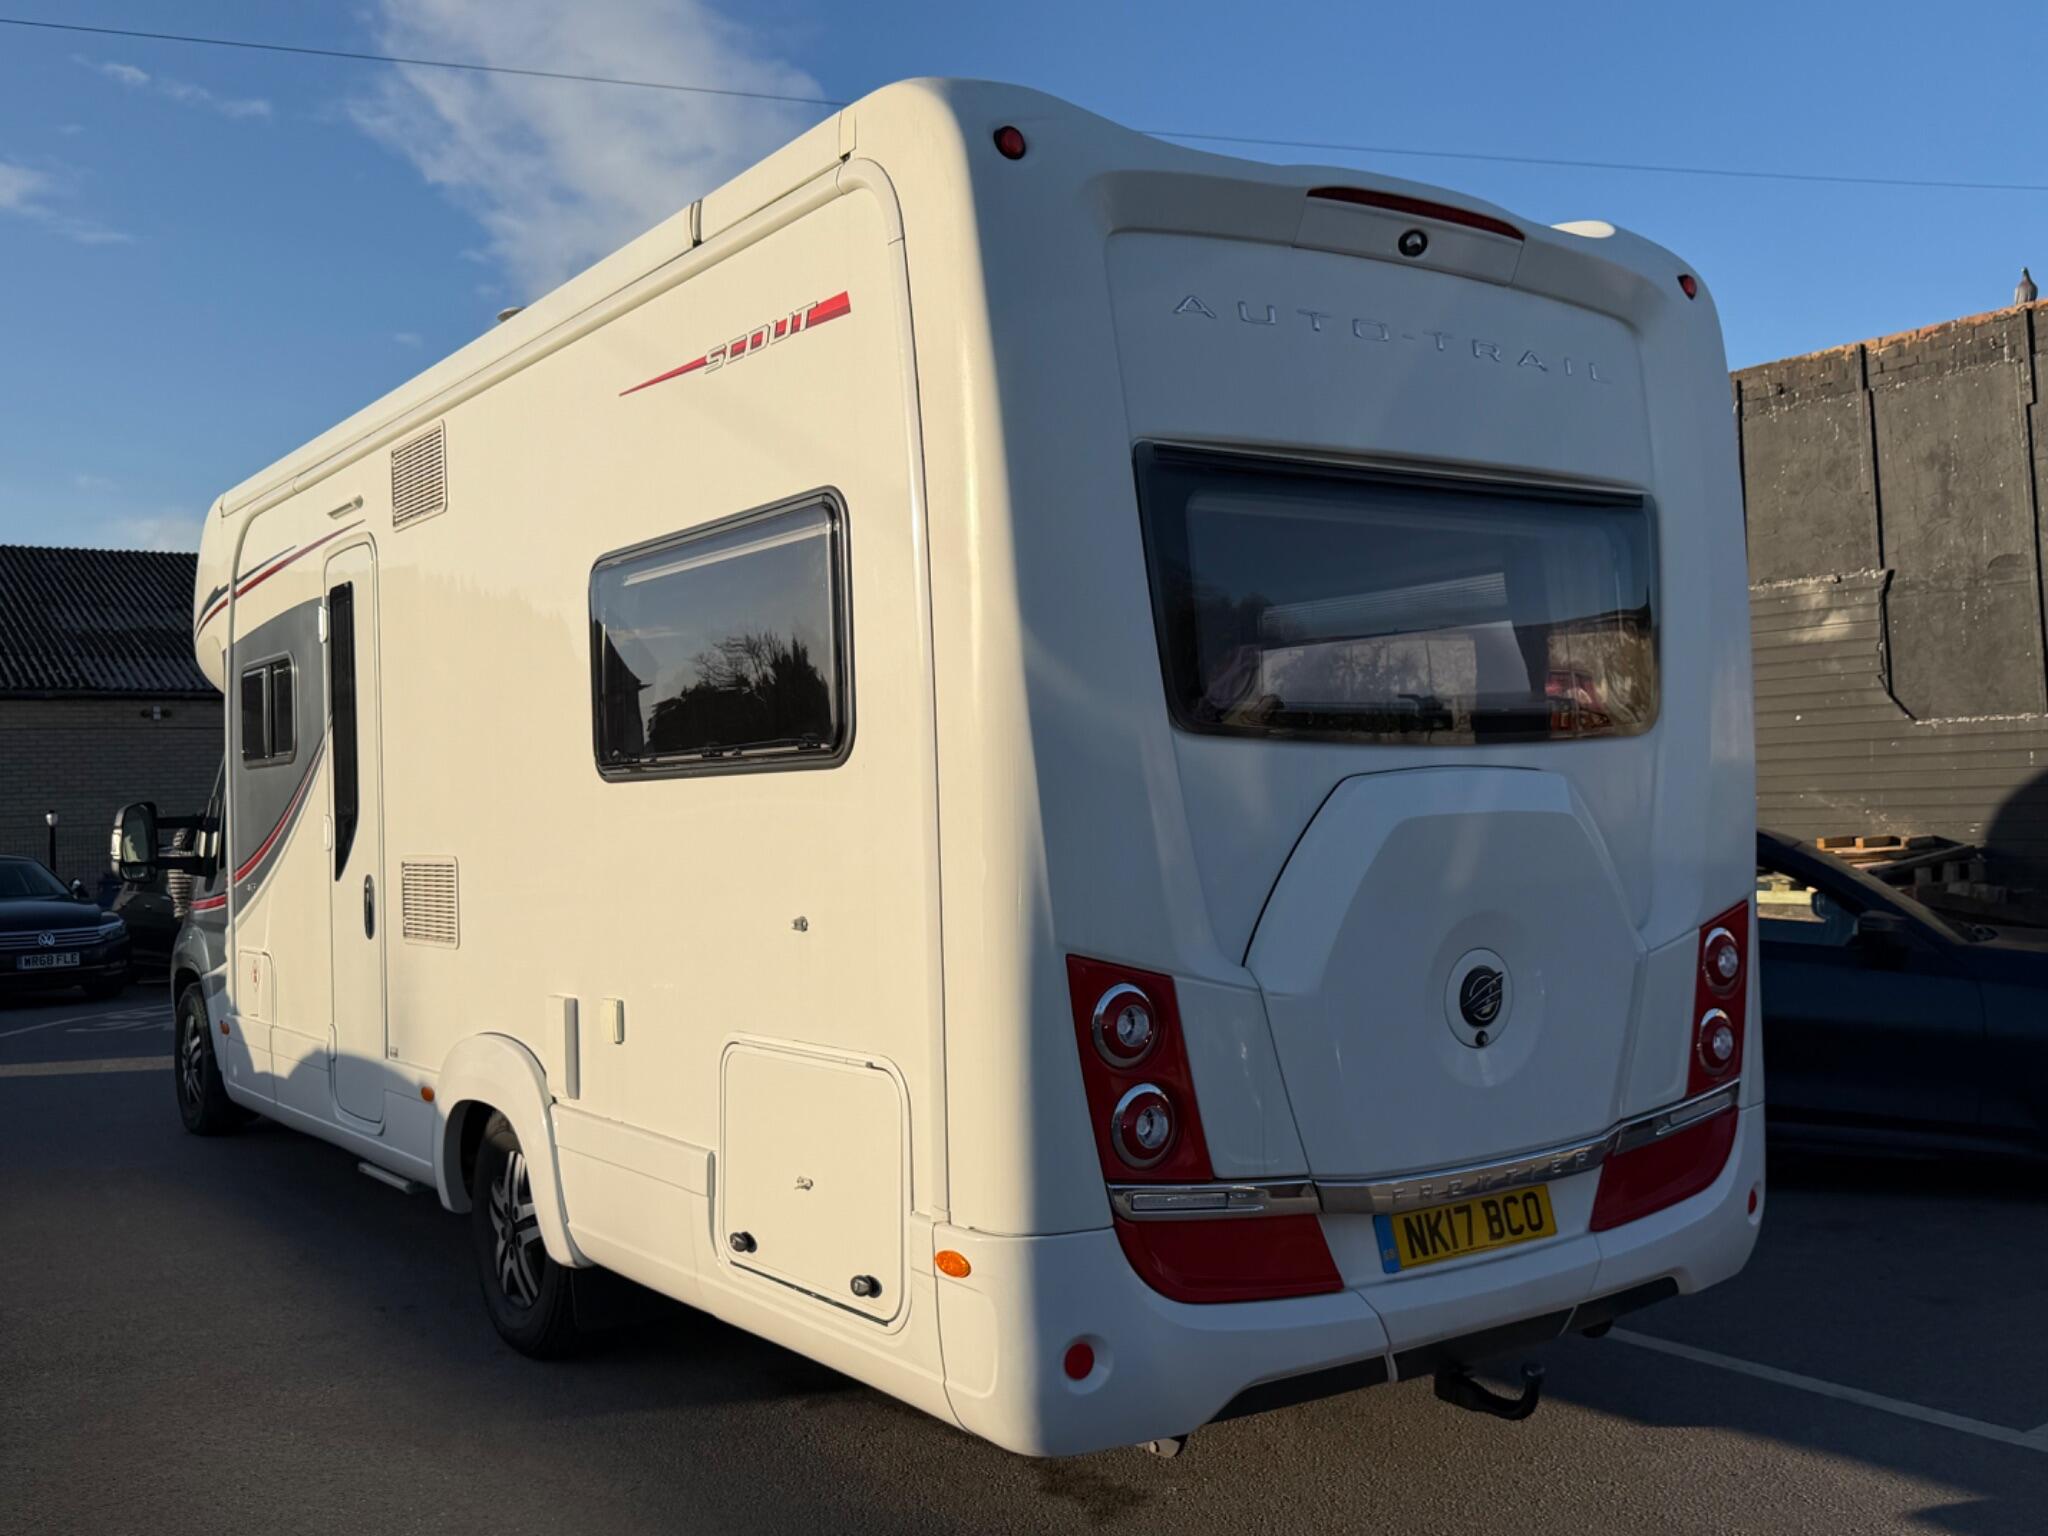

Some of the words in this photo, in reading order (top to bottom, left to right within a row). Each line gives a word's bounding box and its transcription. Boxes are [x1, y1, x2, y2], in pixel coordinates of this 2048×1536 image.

[704, 300, 818, 375] SCOUT
[1173, 294, 1611, 385] AUTO-TRAIL
[56, 952, 78, 965] FLE
[1403, 1204, 1474, 1259] NK17
[1481, 1191, 1545, 1241] BCO
